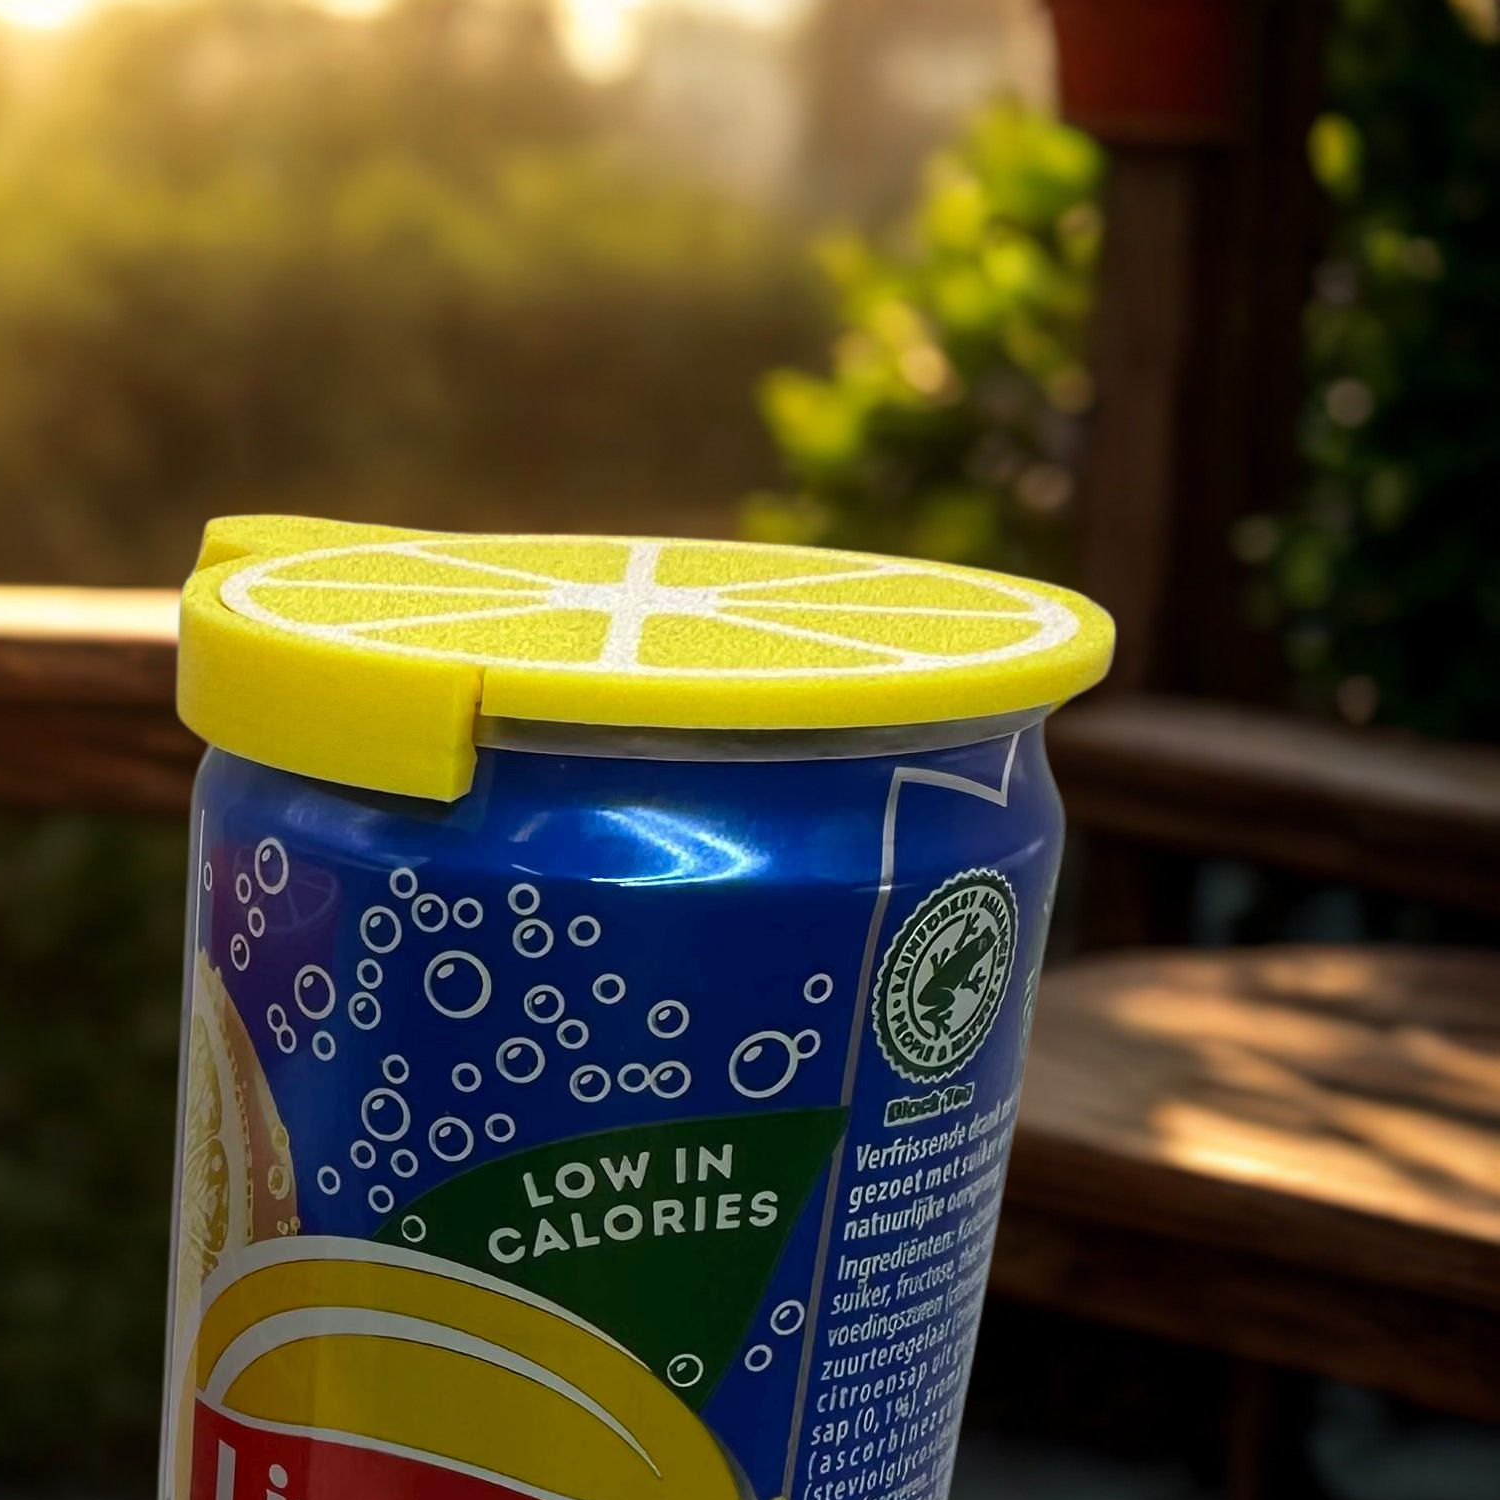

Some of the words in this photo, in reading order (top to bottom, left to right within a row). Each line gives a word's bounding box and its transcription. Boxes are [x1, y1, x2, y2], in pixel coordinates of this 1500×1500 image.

[522, 1152, 649, 1209] LOW
[675, 1143, 735, 1184] IN
[848, 1170, 923, 1214] gezoet
[926, 1157, 959, 1188] met
[487, 1190, 781, 1265] CALORIES
[816, 1362, 928, 1414] citroensap
[810, 1419, 849, 1447] sap
